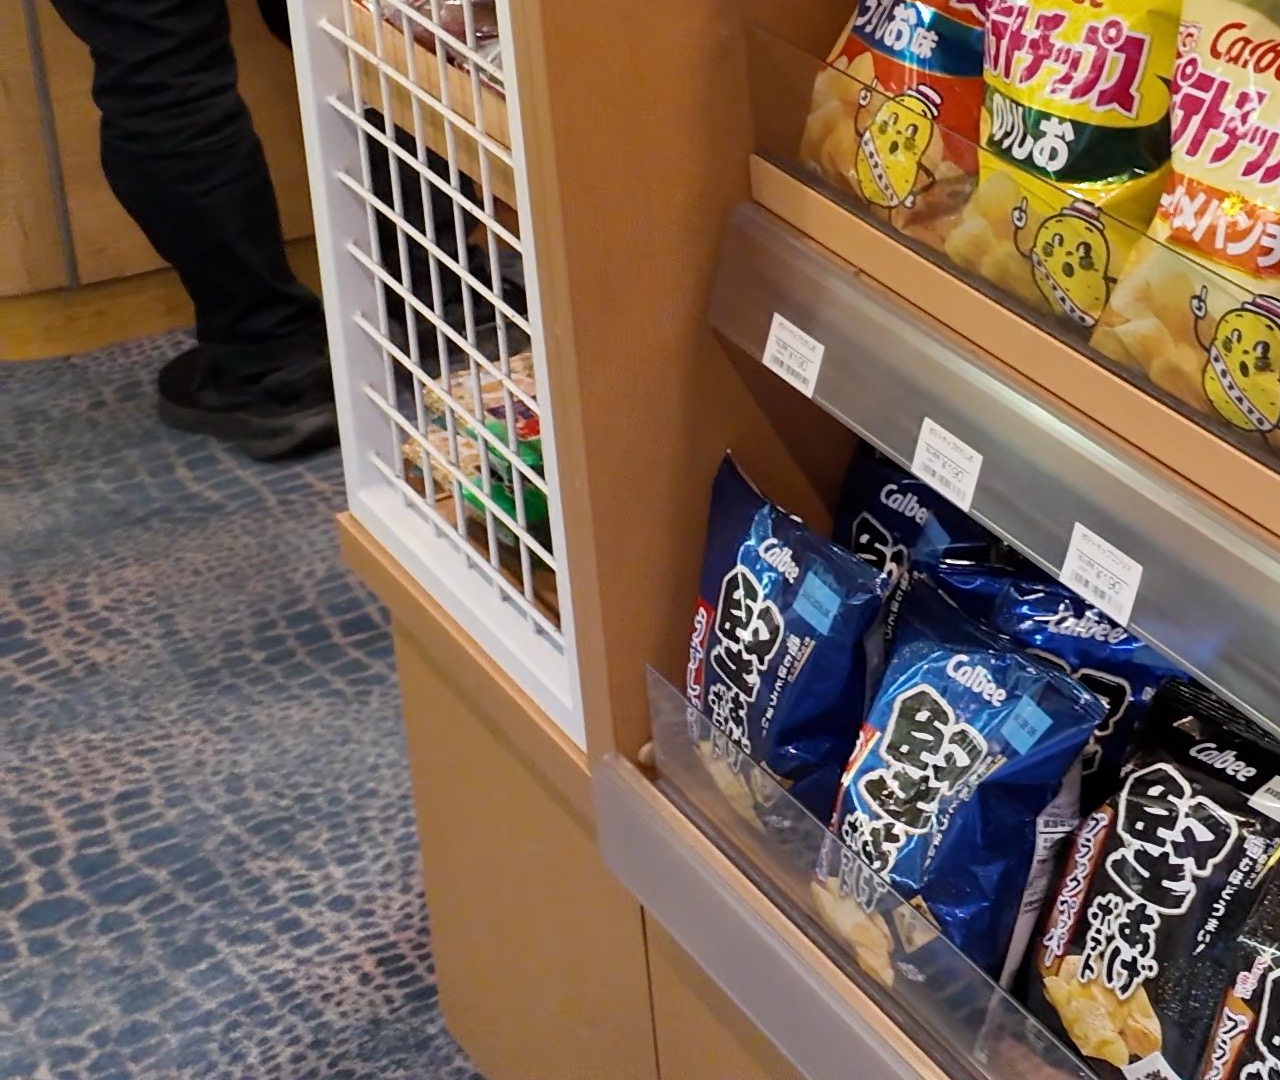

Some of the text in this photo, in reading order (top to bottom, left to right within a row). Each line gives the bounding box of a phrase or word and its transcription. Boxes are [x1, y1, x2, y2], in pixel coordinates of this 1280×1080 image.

[757, 536, 801, 585] Calbee
[946, 653, 1008, 708] Calbee
[1188, 741, 1258, 783] Calbee
